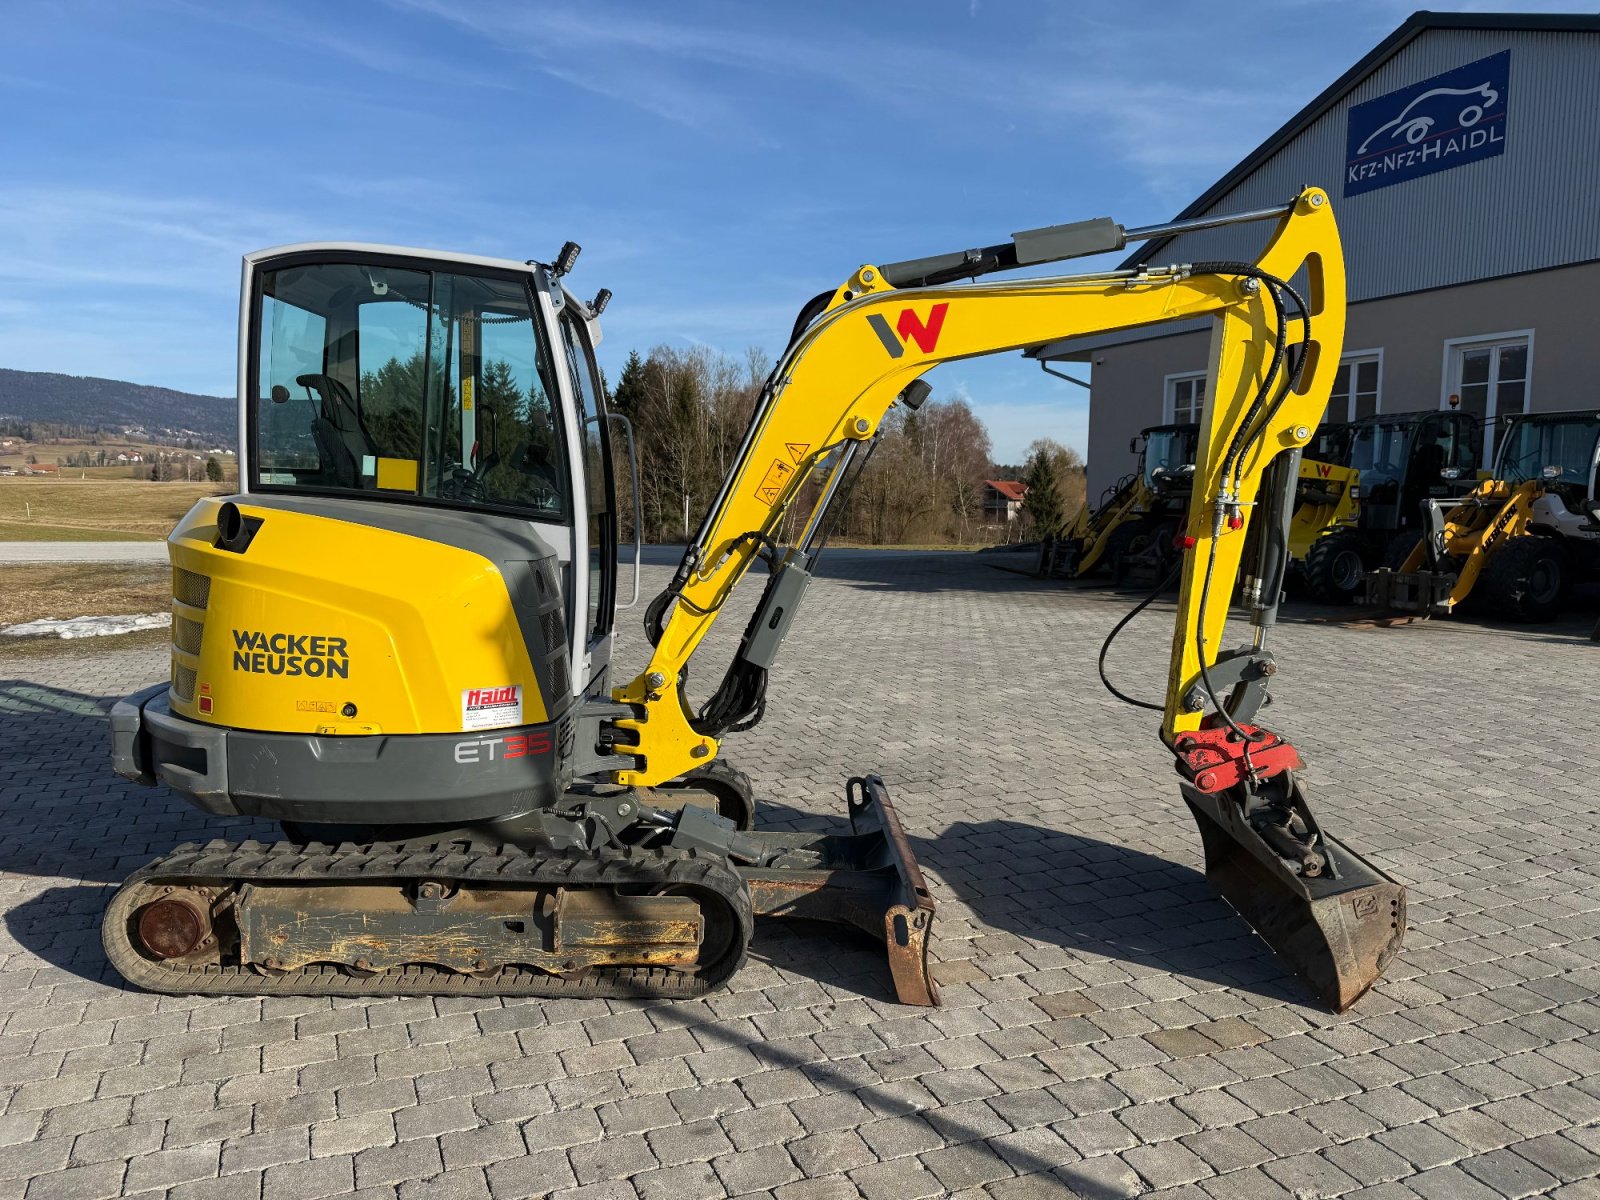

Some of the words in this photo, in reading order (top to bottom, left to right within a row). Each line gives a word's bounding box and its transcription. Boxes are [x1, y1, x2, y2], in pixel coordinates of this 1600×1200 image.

[232, 629, 349, 658] WACKER
[233, 651, 349, 679] NEUSON
[454, 732, 552, 764] ET35
